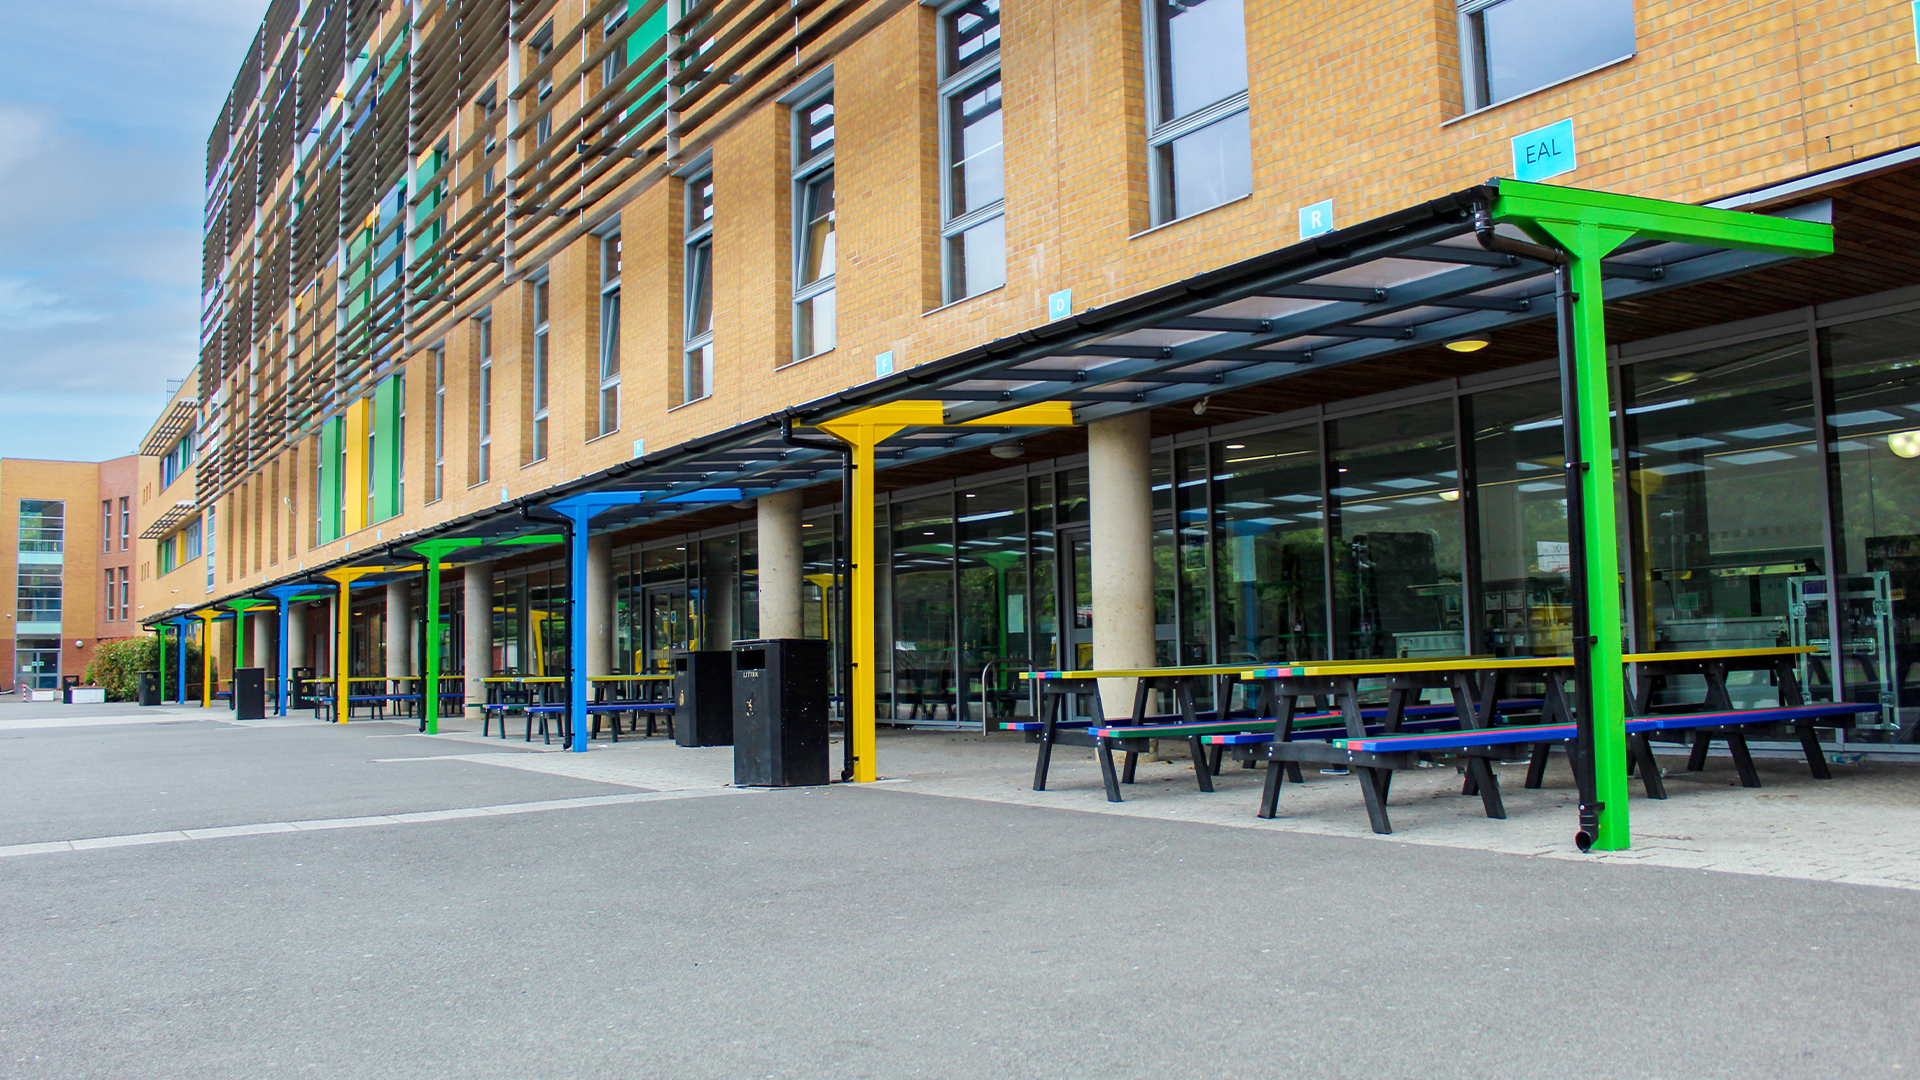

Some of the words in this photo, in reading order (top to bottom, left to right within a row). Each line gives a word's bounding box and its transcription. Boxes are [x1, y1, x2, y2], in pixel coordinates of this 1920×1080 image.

[1526, 138, 1562, 164] EAL
[1311, 210, 1322, 229] R
[882, 358, 888, 372] F
